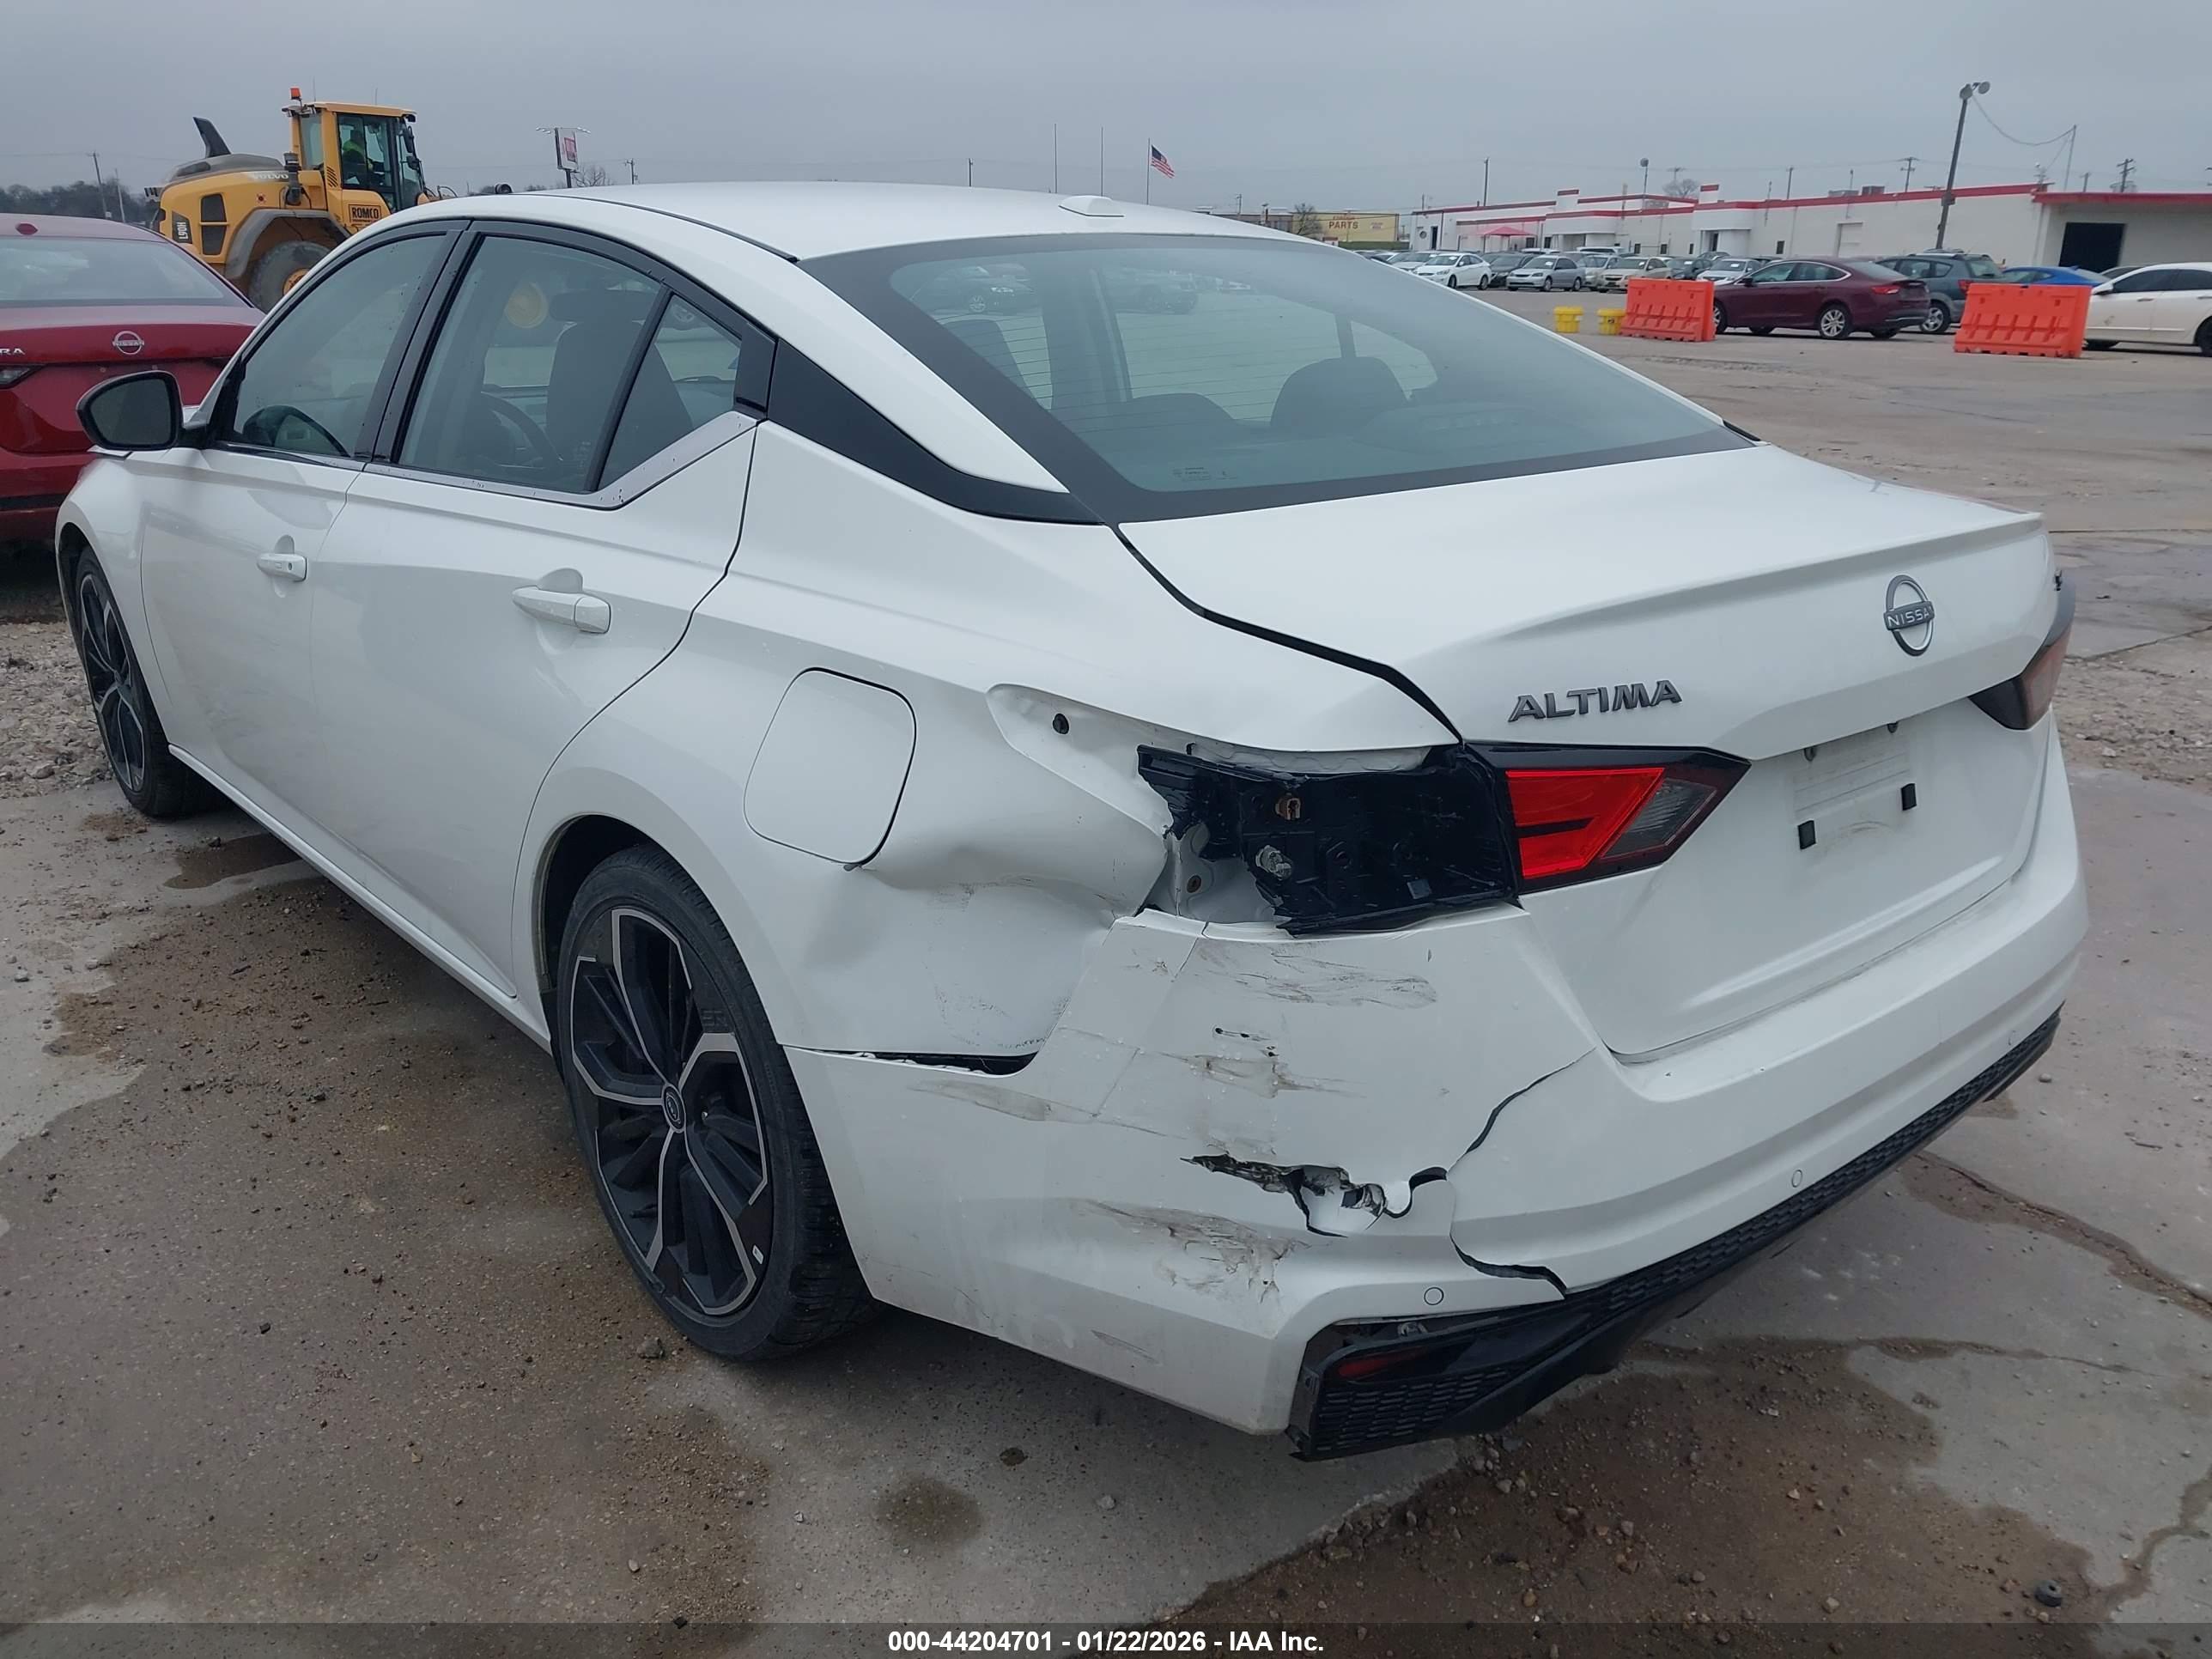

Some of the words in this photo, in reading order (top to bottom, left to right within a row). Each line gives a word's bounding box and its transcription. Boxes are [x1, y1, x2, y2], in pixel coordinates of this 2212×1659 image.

[351, 207, 380, 219] ROMCO
[176, 221, 189, 240] L90H
[1328, 221, 1358, 229] PARTS
[1508, 679, 1683, 723] ALTIMA
